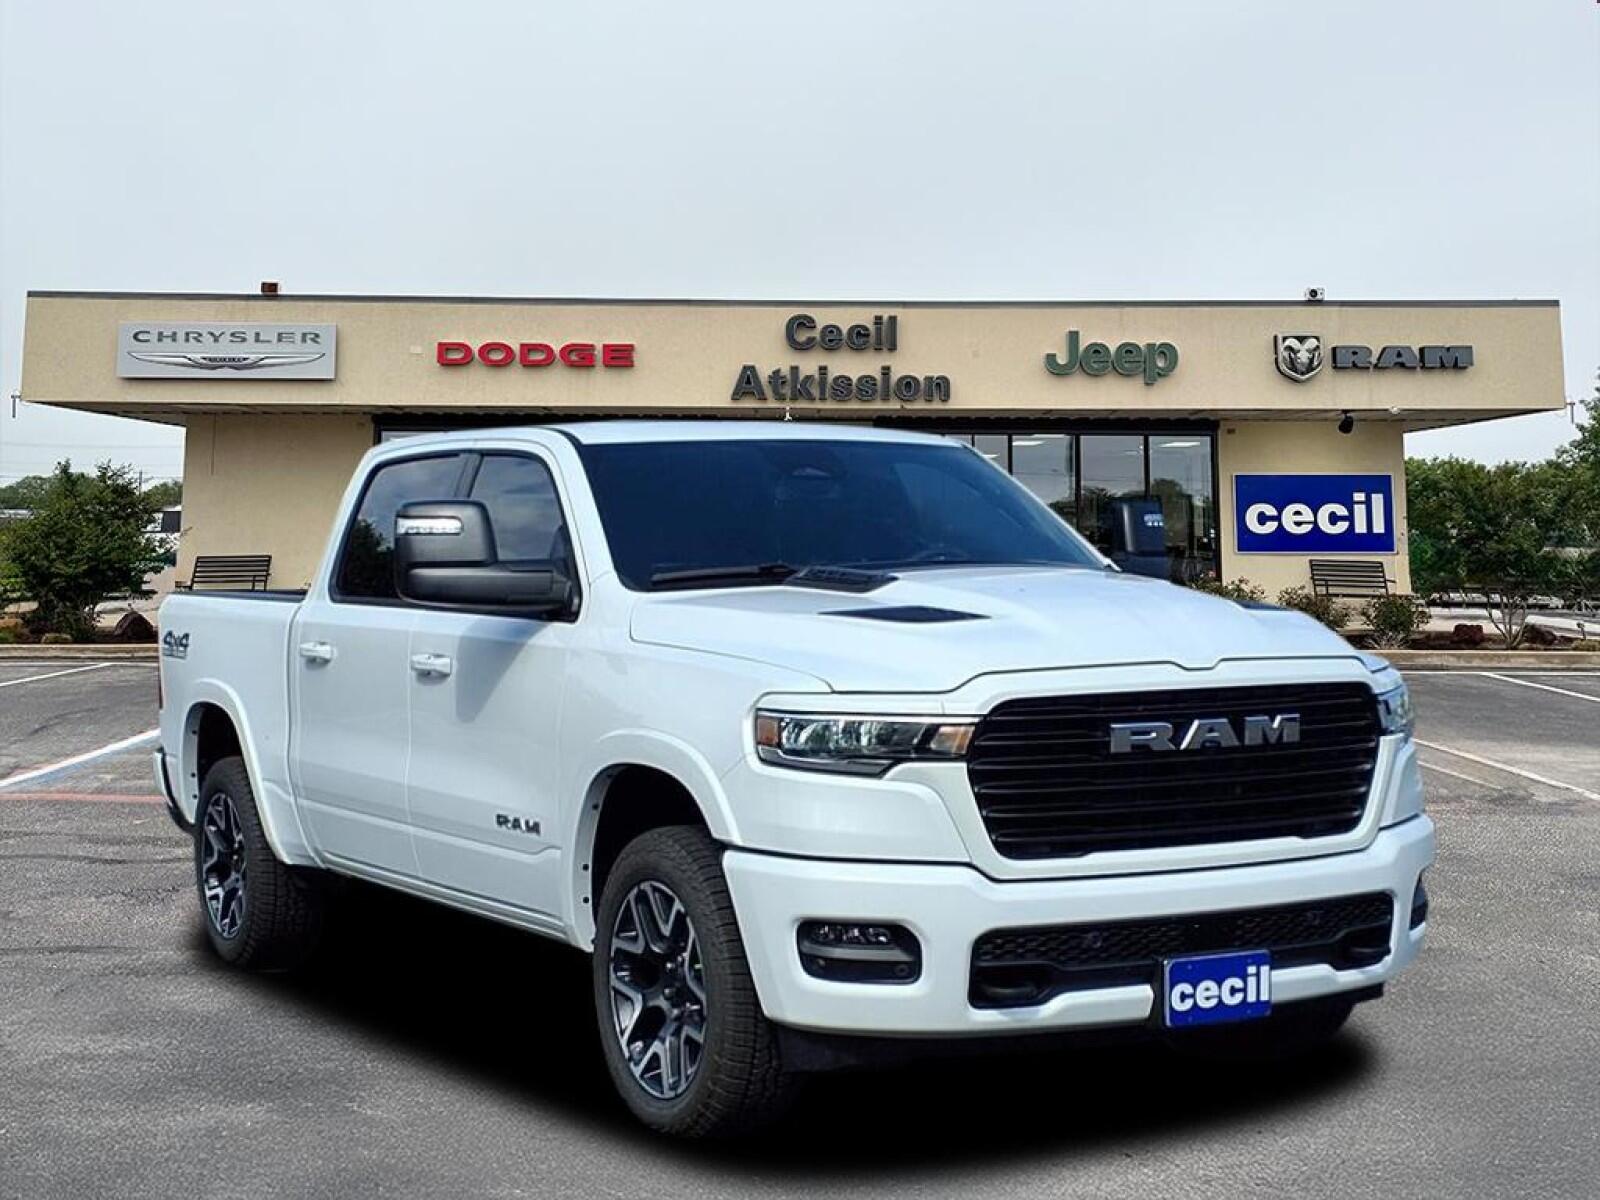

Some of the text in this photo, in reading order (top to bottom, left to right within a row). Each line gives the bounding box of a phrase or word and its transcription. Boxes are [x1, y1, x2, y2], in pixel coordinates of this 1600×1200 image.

[132, 329, 321, 345] CHRYSLER
[785, 314, 898, 351] Cecil
[437, 342, 635, 368] DODGE
[1045, 330, 1178, 385] Jeep
[1332, 345, 1473, 370] RAM
[731, 365, 951, 402] Atkission
[1245, 492, 1385, 534] cecil
[1110, 713, 1301, 753] RAM
[496, 813, 541, 836] RAM
[1171, 965, 1270, 1011] cecil
